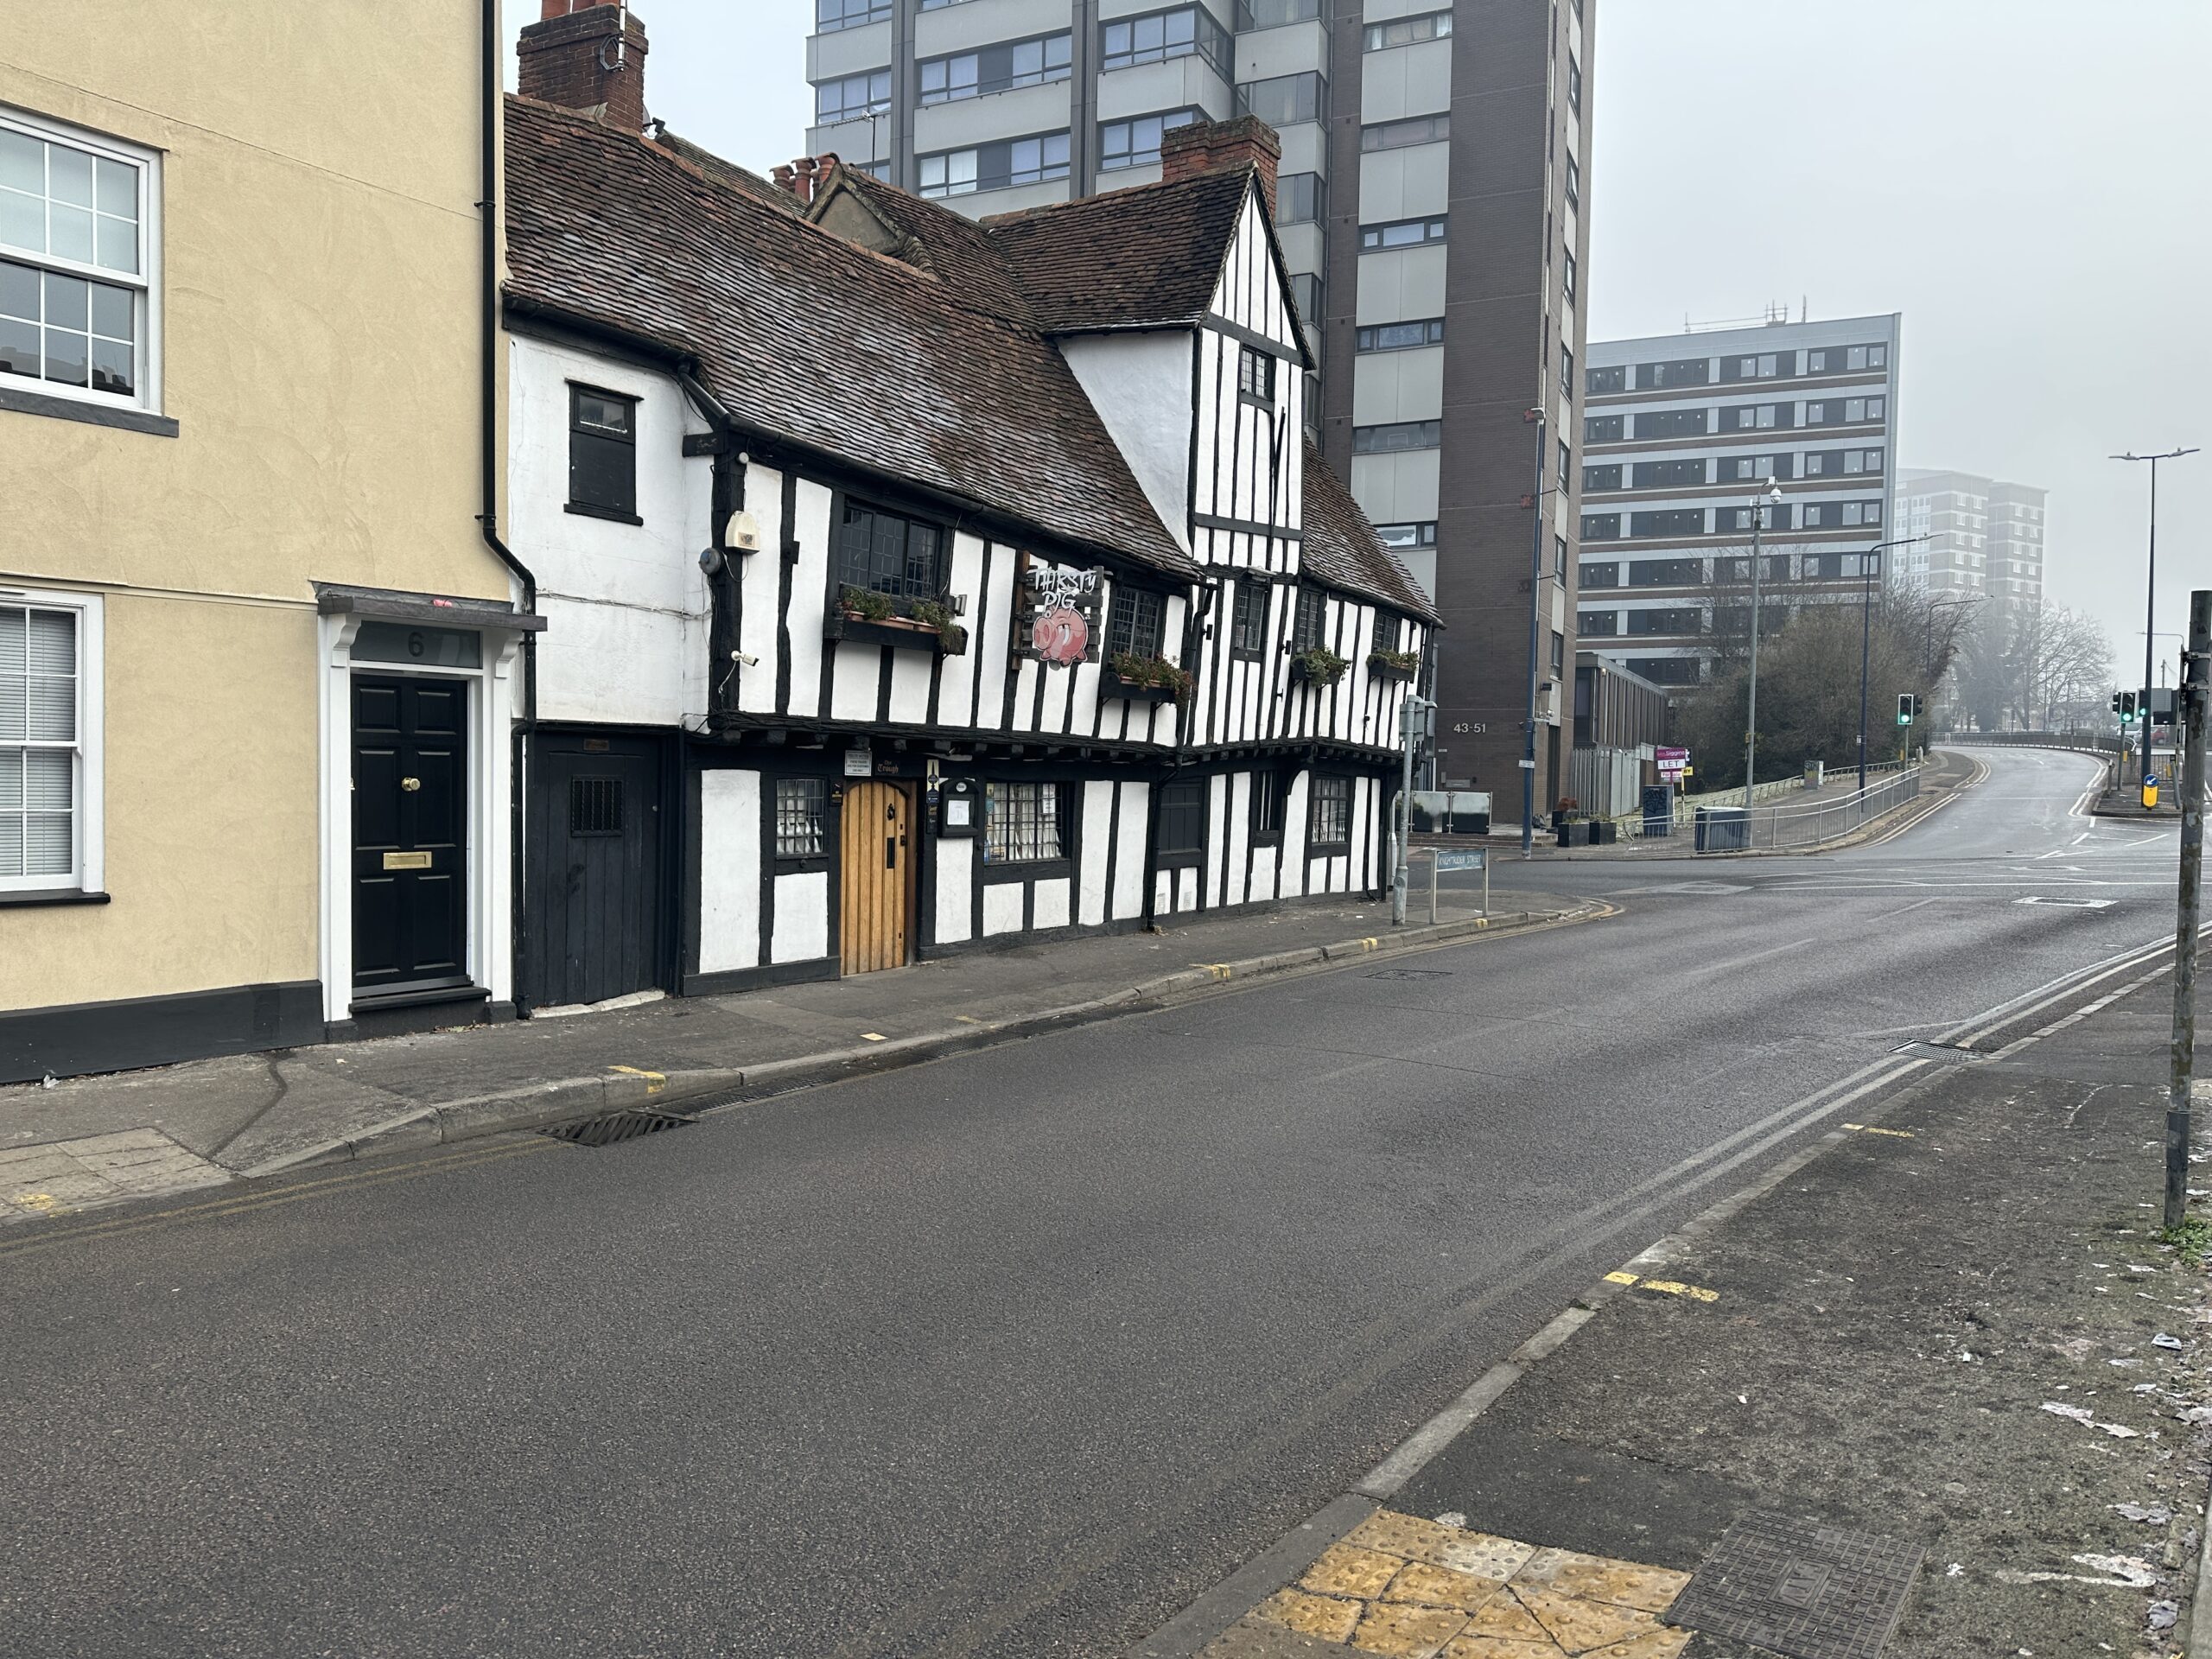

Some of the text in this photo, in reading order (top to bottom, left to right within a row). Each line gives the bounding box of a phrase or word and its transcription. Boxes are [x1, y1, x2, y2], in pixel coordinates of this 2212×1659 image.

[1027, 566, 1096, 593] THIRSTY
[1042, 590, 1077, 617] PIG
[408, 632, 424, 657] 6
[1453, 722, 1486, 733] 43-51
[1466, 855, 1481, 864] STREET
